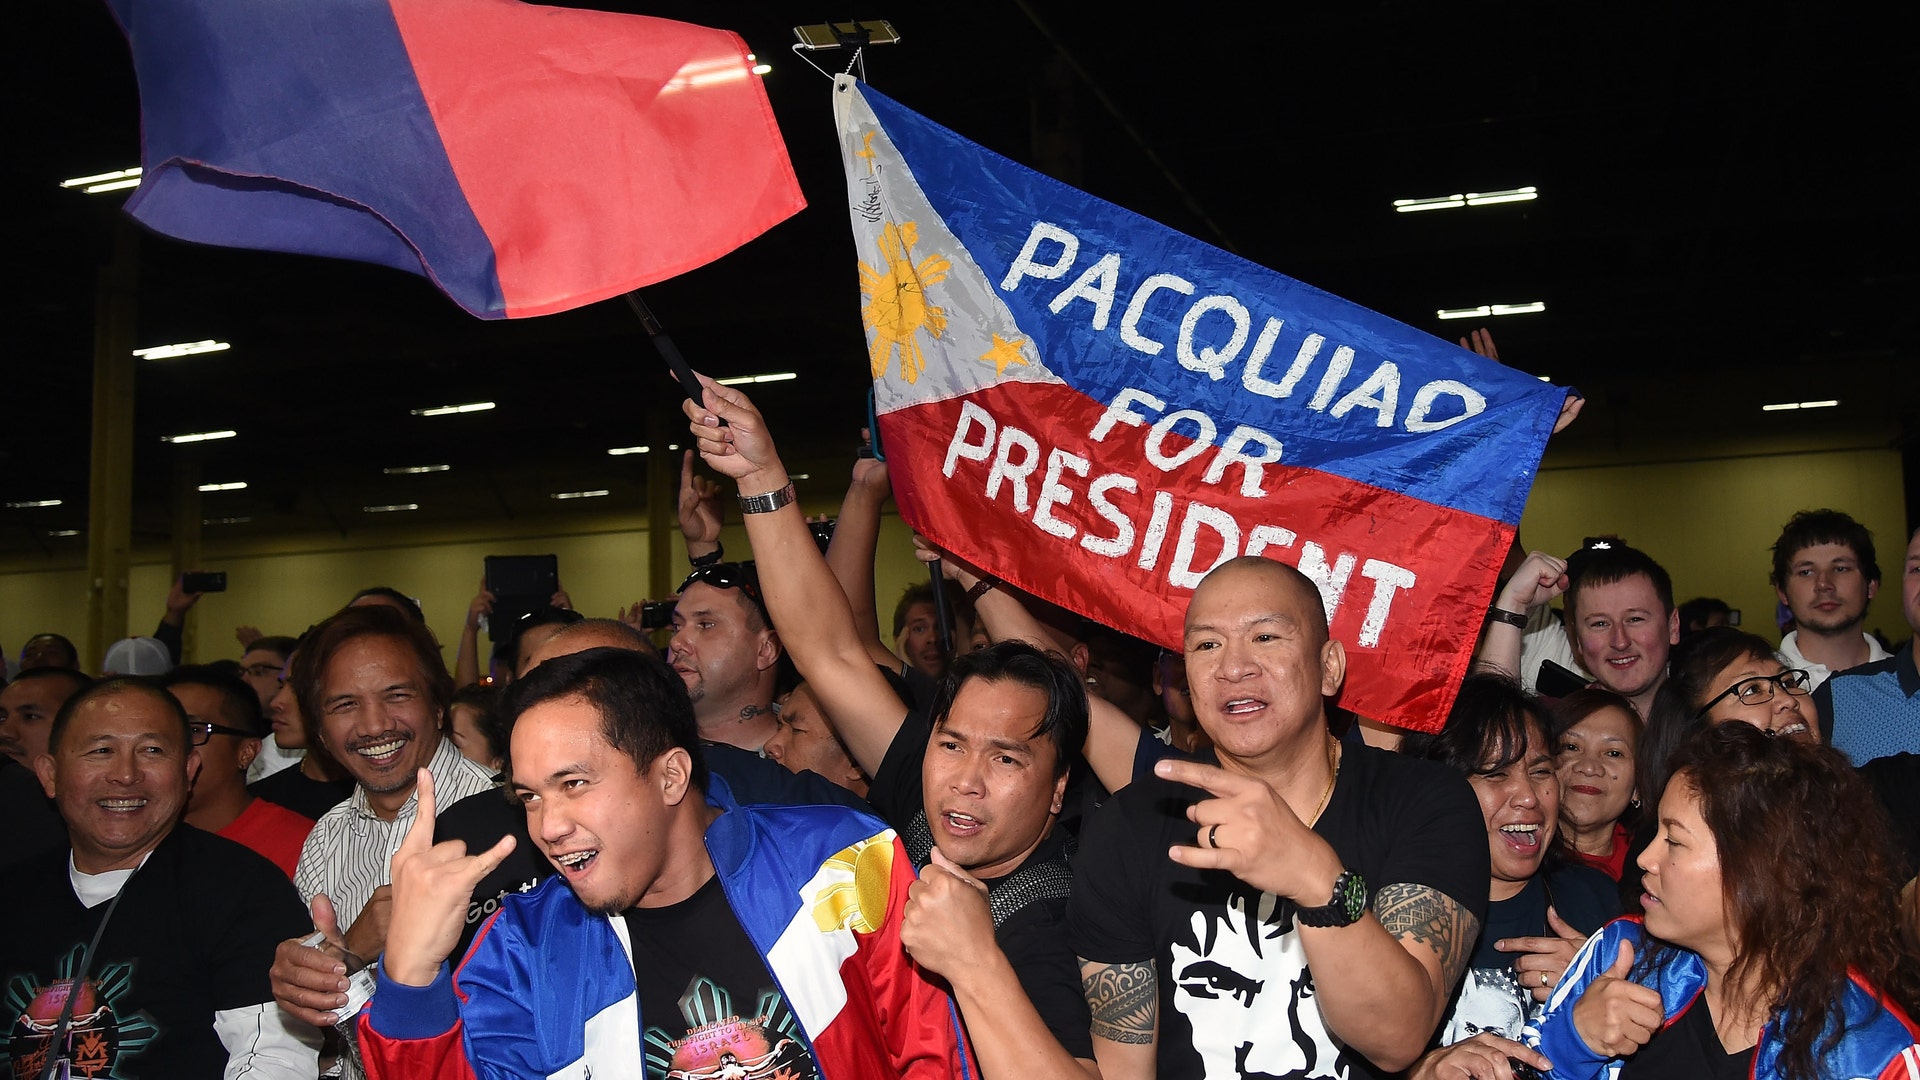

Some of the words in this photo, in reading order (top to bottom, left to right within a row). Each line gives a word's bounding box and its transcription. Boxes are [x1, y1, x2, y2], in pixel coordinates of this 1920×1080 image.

[1000, 221, 1488, 432] PACQUIAO
[1089, 388, 1283, 498] FOR
[666, 1039, 688, 1050] THIS
[690, 1031, 718, 1044] FIGHT
[718, 1026, 735, 1037] TO
[735, 1021, 750, 1032] MY
[750, 1014, 772, 1026] SON
[686, 1015, 740, 1036] DEDICATED
[693, 1032, 753, 1056] ISRAEL
